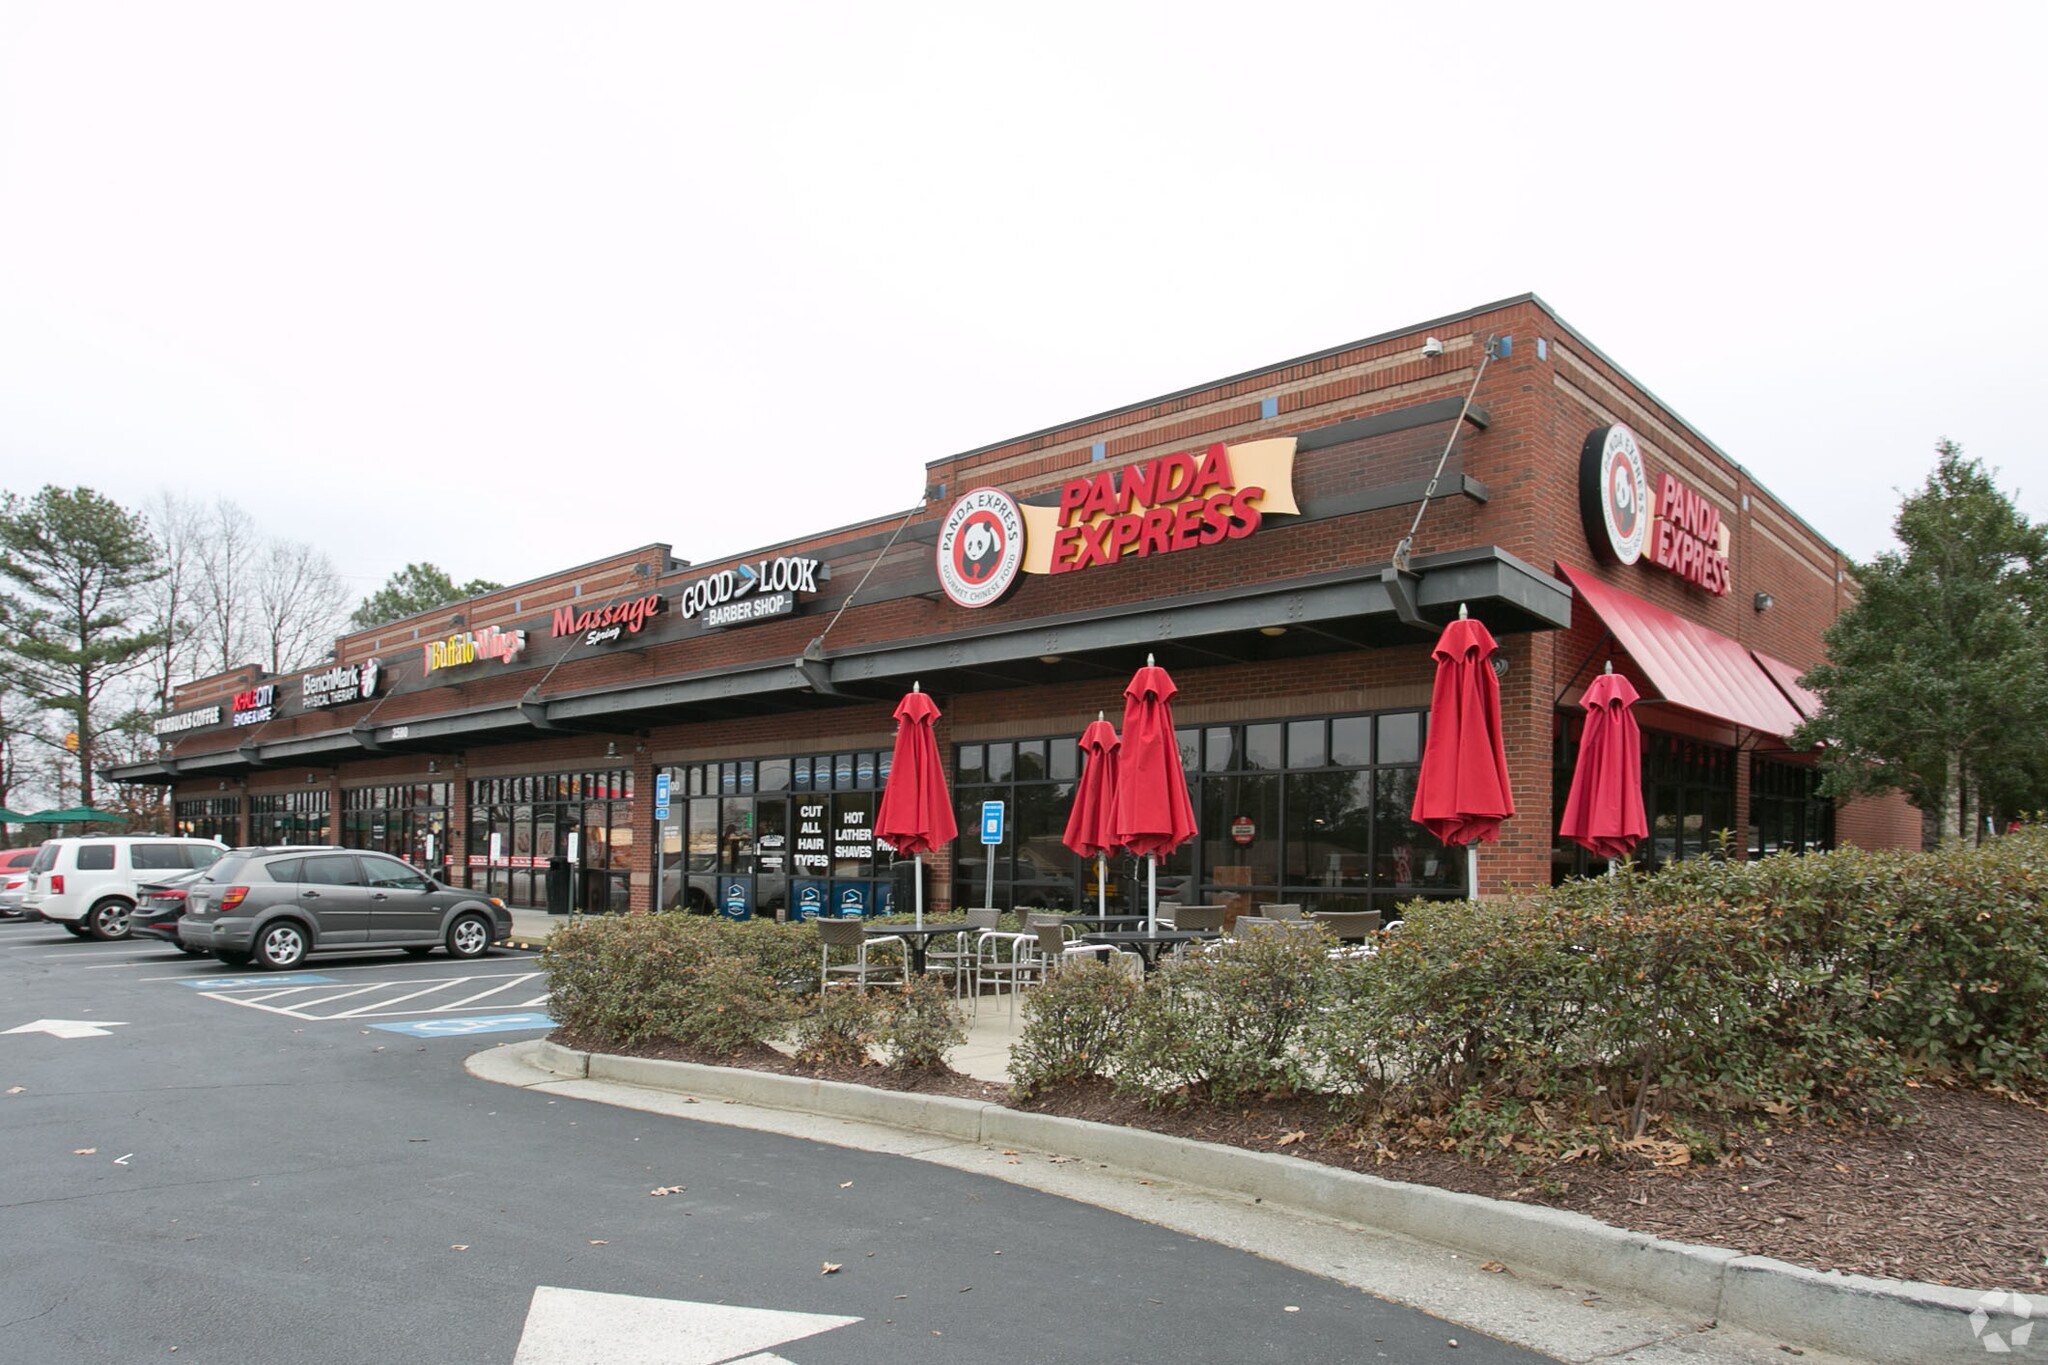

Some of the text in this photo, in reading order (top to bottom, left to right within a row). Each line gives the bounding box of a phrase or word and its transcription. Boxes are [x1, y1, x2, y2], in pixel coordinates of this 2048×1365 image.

[1058, 442, 1235, 529] PANDA
[942, 494, 1018, 551] PANDA EXPRESS
[1658, 474, 1721, 547] PANDA
[1050, 486, 1265, 575] EXPRESS
[1653, 520, 1730, 596] EXPRESS
[682, 556, 818, 619] GOOD LOOK
[943, 554, 1016, 601] GOURMET CHINESE FOOD
[551, 594, 660, 639] Massage
[709, 595, 785, 626] BARBER SHOP
[431, 632, 478, 671] Buffalo
[474, 625, 526, 665] Wings
[585, 626, 620, 646] Spring
[303, 664, 359, 696] BenchMark
[303, 687, 358, 710] PHYSICAL THERAPY
[153, 706, 220, 736] STARBUCKS COFFEE
[800, 805, 823, 818] CUT
[844, 811, 865, 824] HOT
[801, 821, 822, 834] ALL
[835, 828, 872, 841] LATHER
[797, 838, 825, 850] HAIR
[835, 845, 873, 858] SHAVES
[794, 854, 829, 867] TYPES
